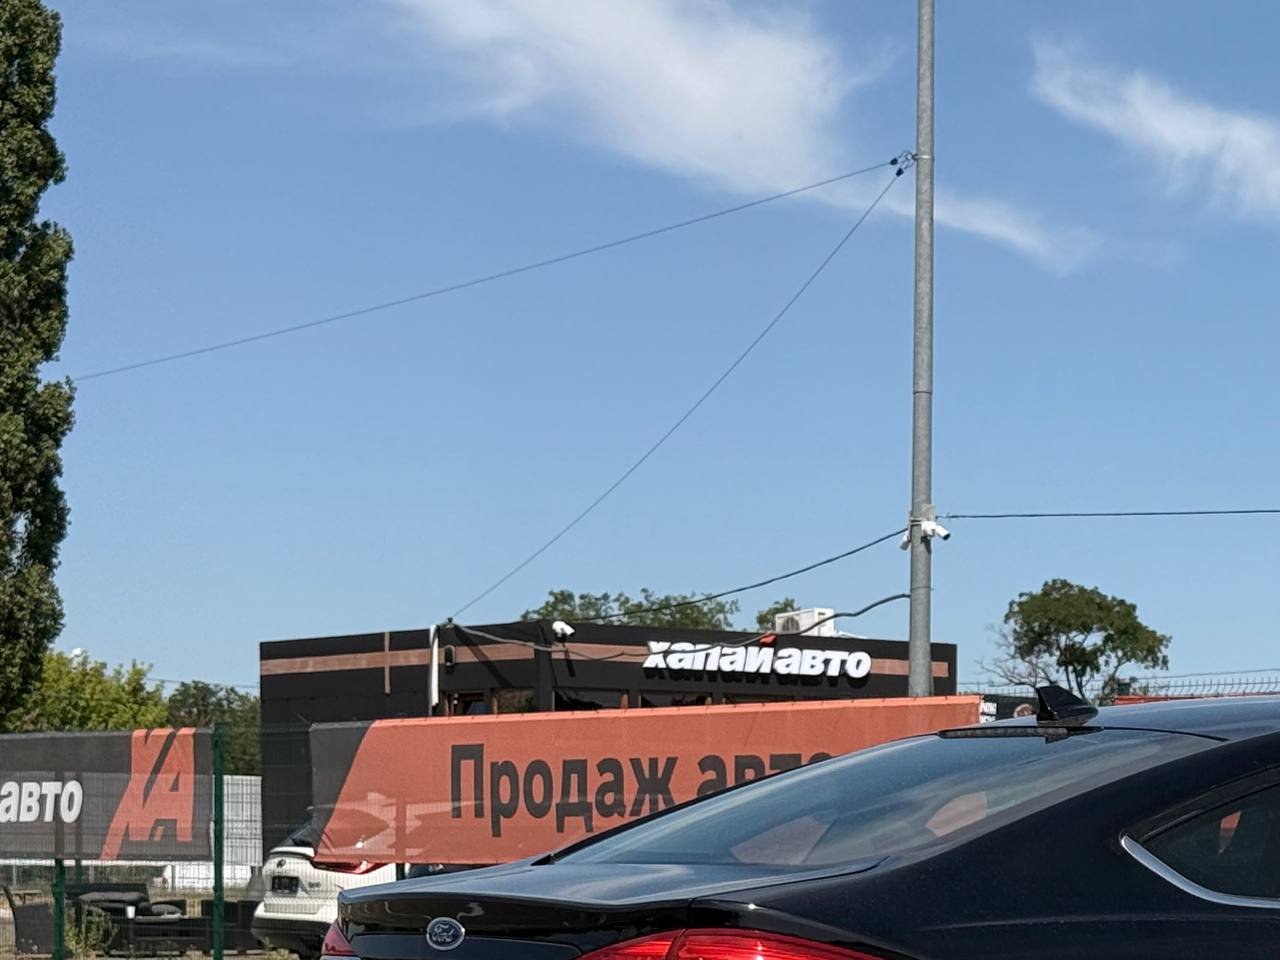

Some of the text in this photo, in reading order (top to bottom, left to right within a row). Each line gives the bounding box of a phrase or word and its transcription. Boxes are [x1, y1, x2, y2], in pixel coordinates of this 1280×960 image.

[643, 632, 872, 679] хапай авто
[0, 780, 83, 824] авто
[451, 743, 679, 838] Продаж
